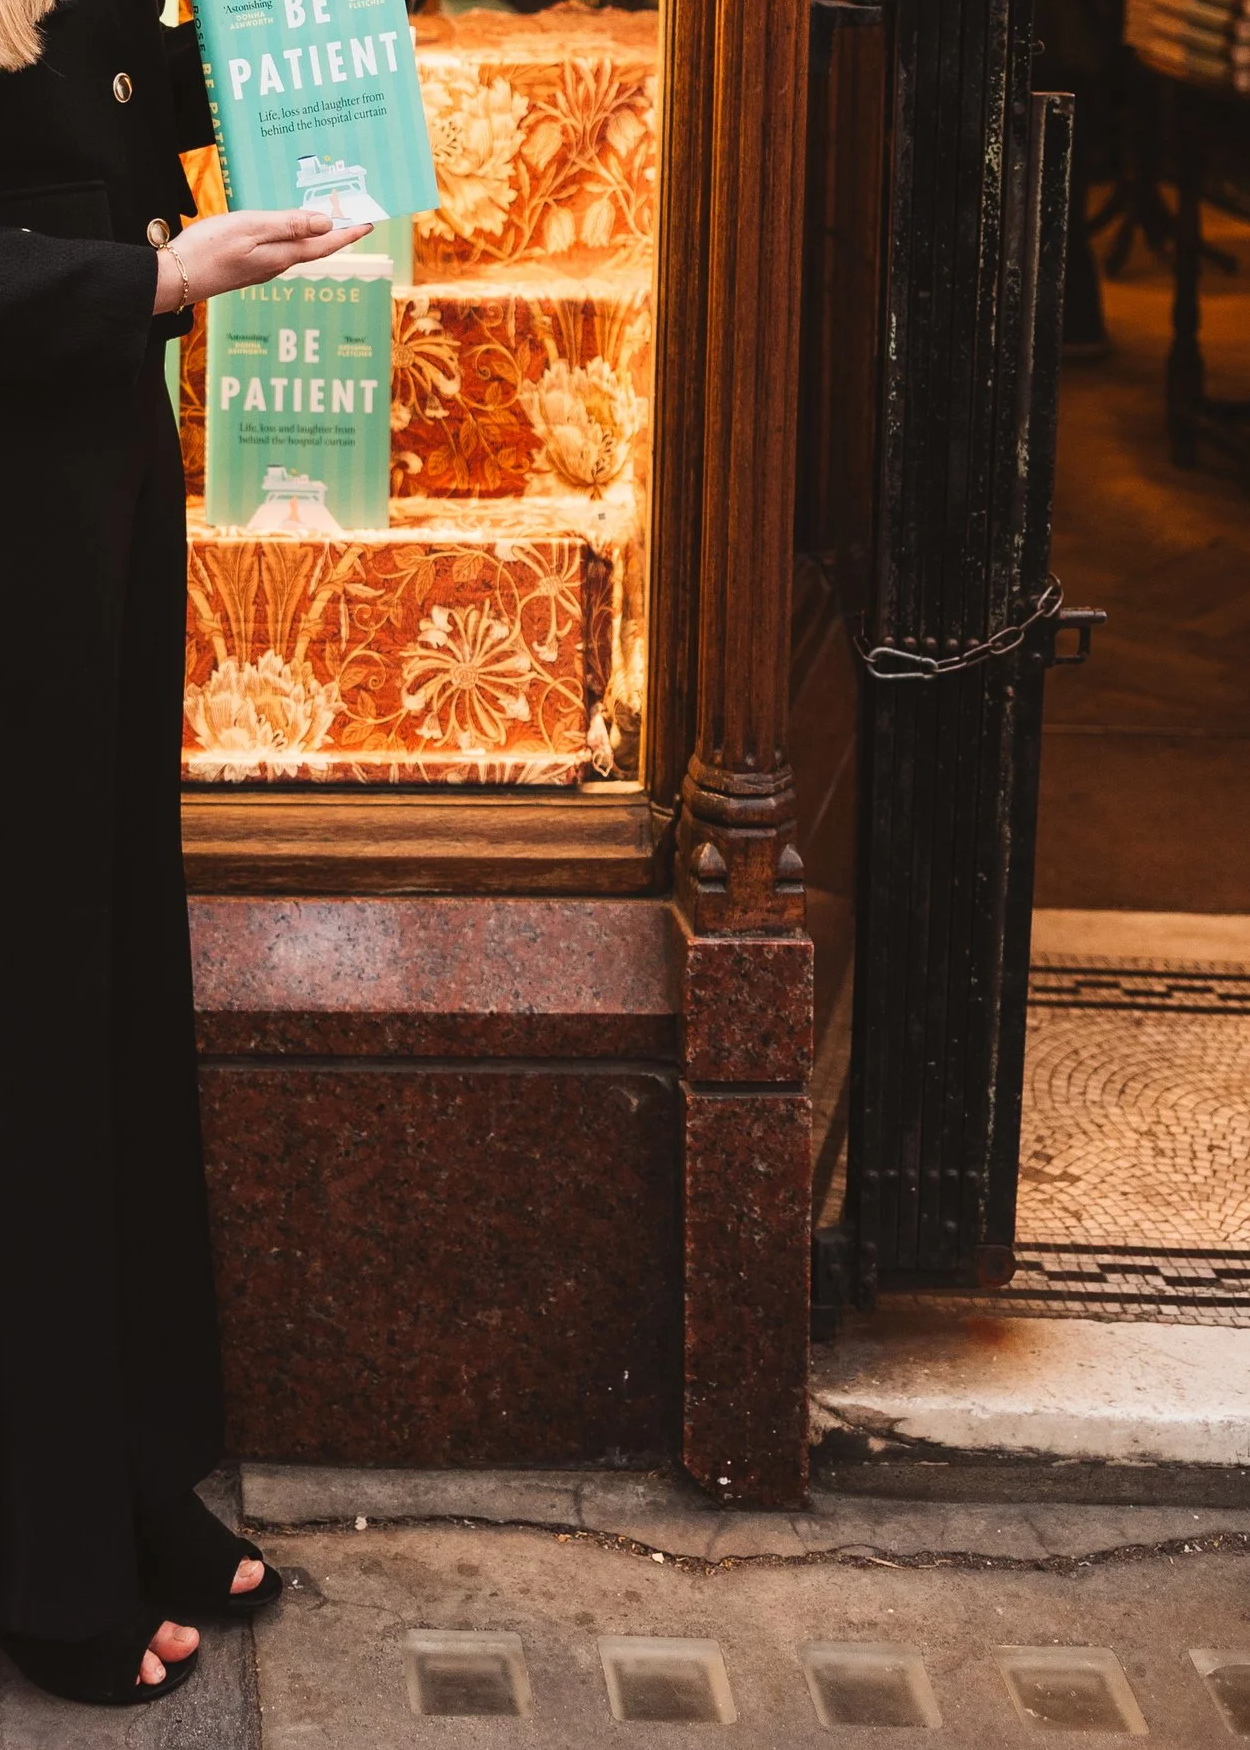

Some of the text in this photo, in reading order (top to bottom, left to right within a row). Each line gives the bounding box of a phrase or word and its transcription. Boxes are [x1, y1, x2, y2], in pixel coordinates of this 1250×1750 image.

[230, 17, 274, 30] ASHWORTH
[235, 11, 265, 22] DONNA
[228, 31, 398, 100] PATIENT
[259, 92, 385, 122] Life, loss and laughter from
[260, 106, 387, 137] behind the hospital curtain
[202, 63, 215, 88] BE
[209, 102, 233, 198] PATIENT
[239, 287, 360, 303] TILLY ROSE
[279, 328, 320, 363] BE
[220, 377, 378, 413] PATIENT
